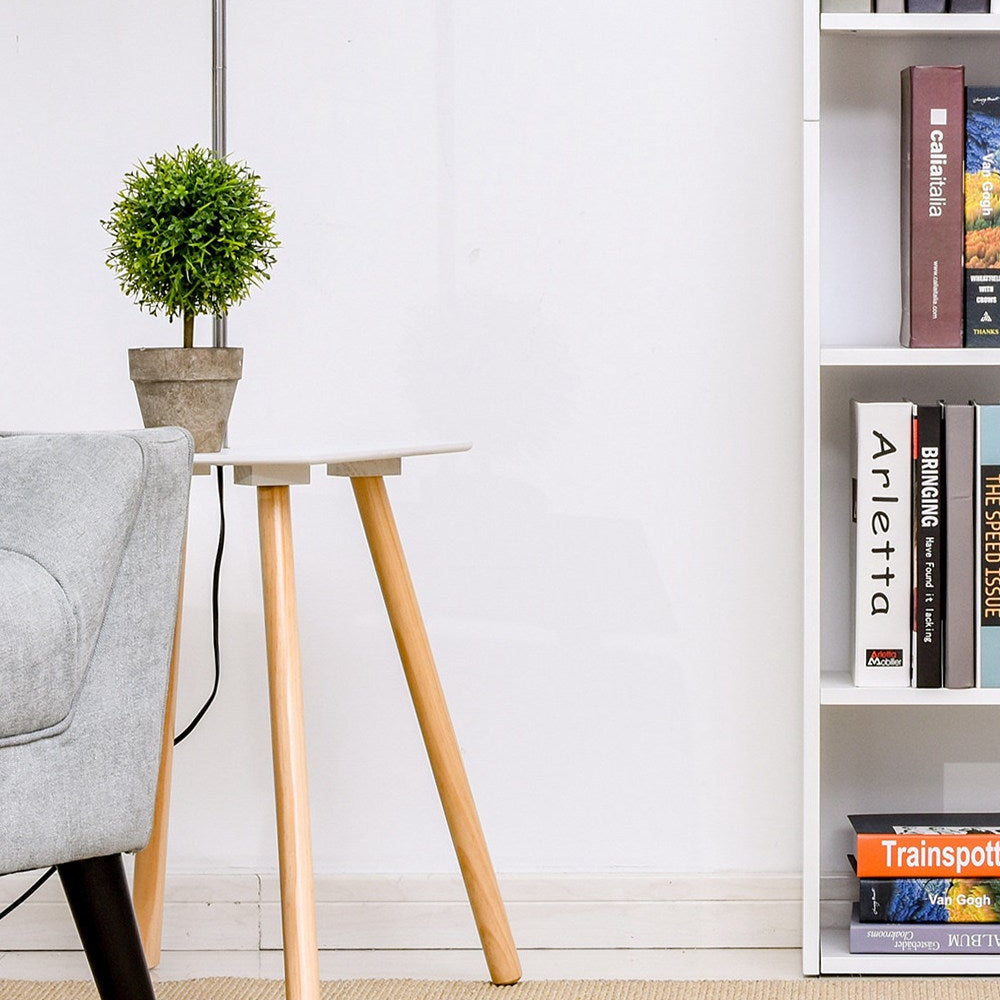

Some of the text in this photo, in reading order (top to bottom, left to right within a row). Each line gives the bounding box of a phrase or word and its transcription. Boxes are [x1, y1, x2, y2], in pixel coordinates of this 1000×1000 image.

[929, 130, 947, 217] caliaitalia
[980, 153, 994, 216] Van Gogh
[922, 447, 938, 528] BRINGING
[871, 430, 899, 616] Arletta
[925, 559, 935, 588] Found
[926, 592, 933, 602] it
[924, 604, 935, 643] lacking
[928, 893, 990, 908] Van Gogh
[867, 931, 914, 940] Cloakrooms
